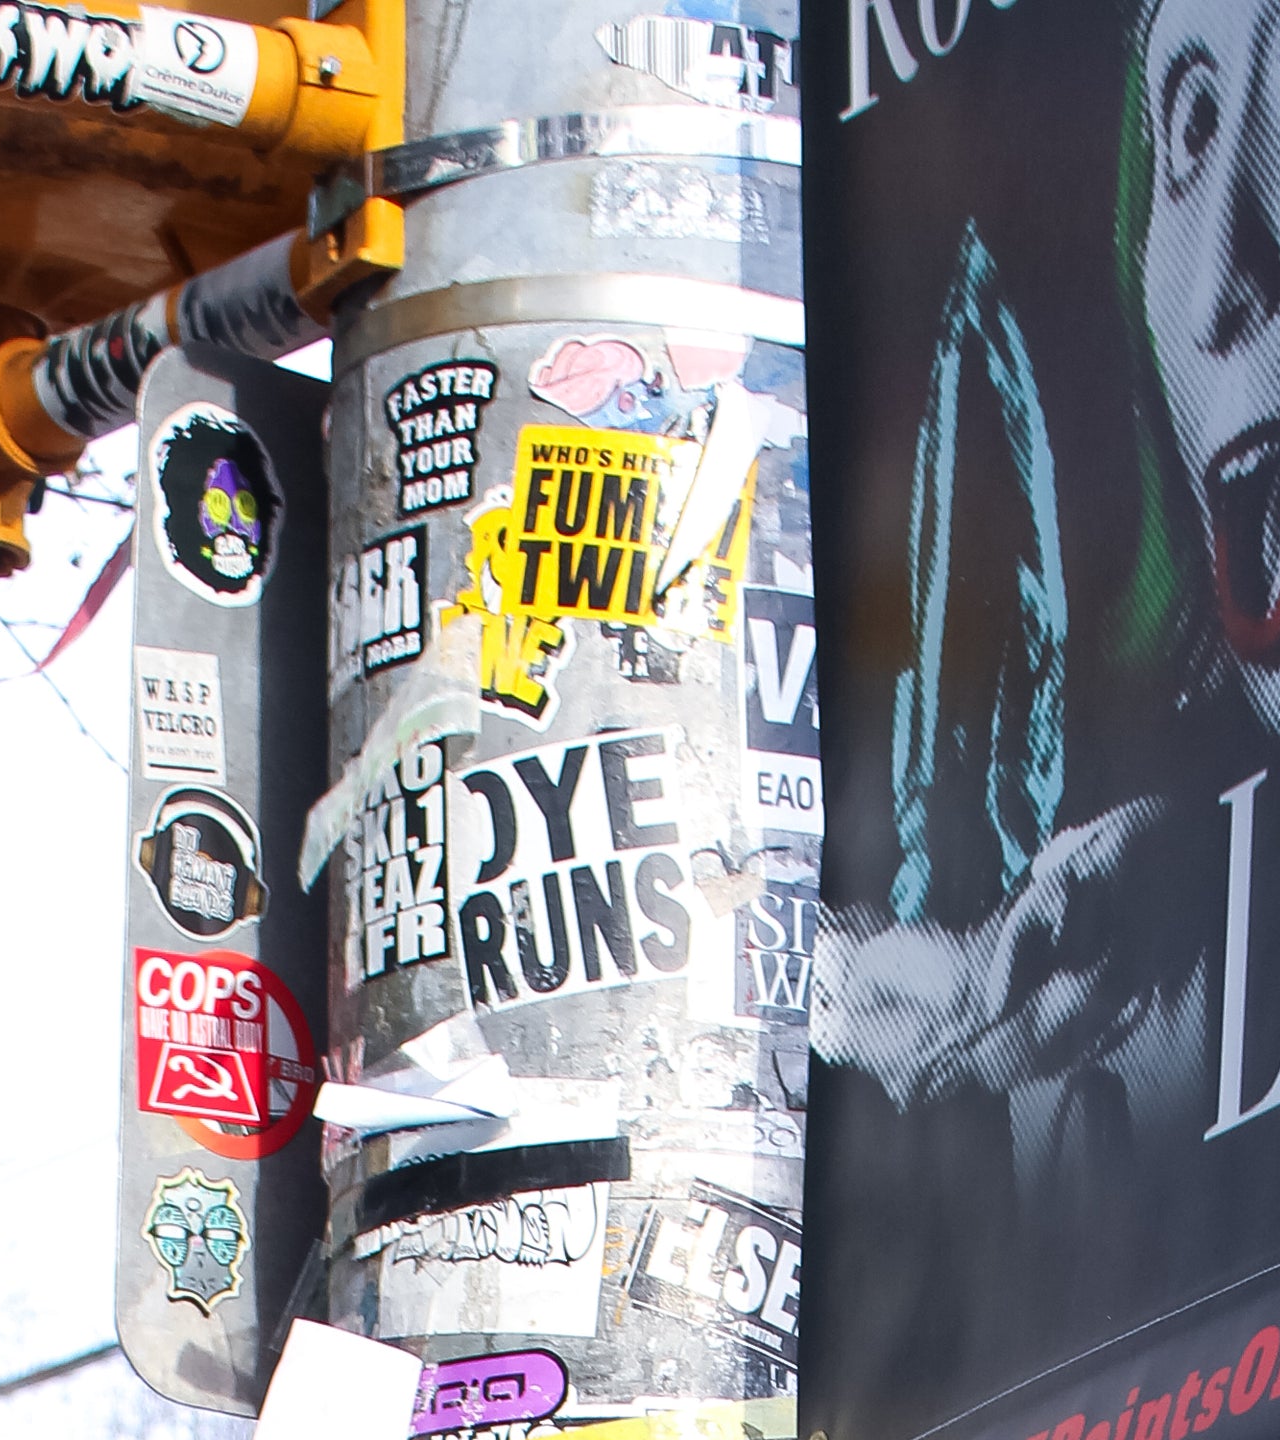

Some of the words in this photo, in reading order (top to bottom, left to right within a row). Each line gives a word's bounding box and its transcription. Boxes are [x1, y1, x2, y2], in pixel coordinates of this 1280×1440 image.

[387, 366, 495, 422] FASTER
[398, 402, 477, 446] THAN
[400, 436, 474, 479] YOUR
[403, 469, 469, 512] MOM
[142, 676, 211, 705] WASP
[143, 707, 218, 737] VELCRO
[458, 852, 692, 1011] RUNS
[138, 956, 263, 1021] COPS
[139, 1005, 170, 1041] HAVE
[171, 1009, 189, 1044] NO
[190, 1012, 233, 1049] ASTRAL
[233, 1018, 264, 1053] BODY
